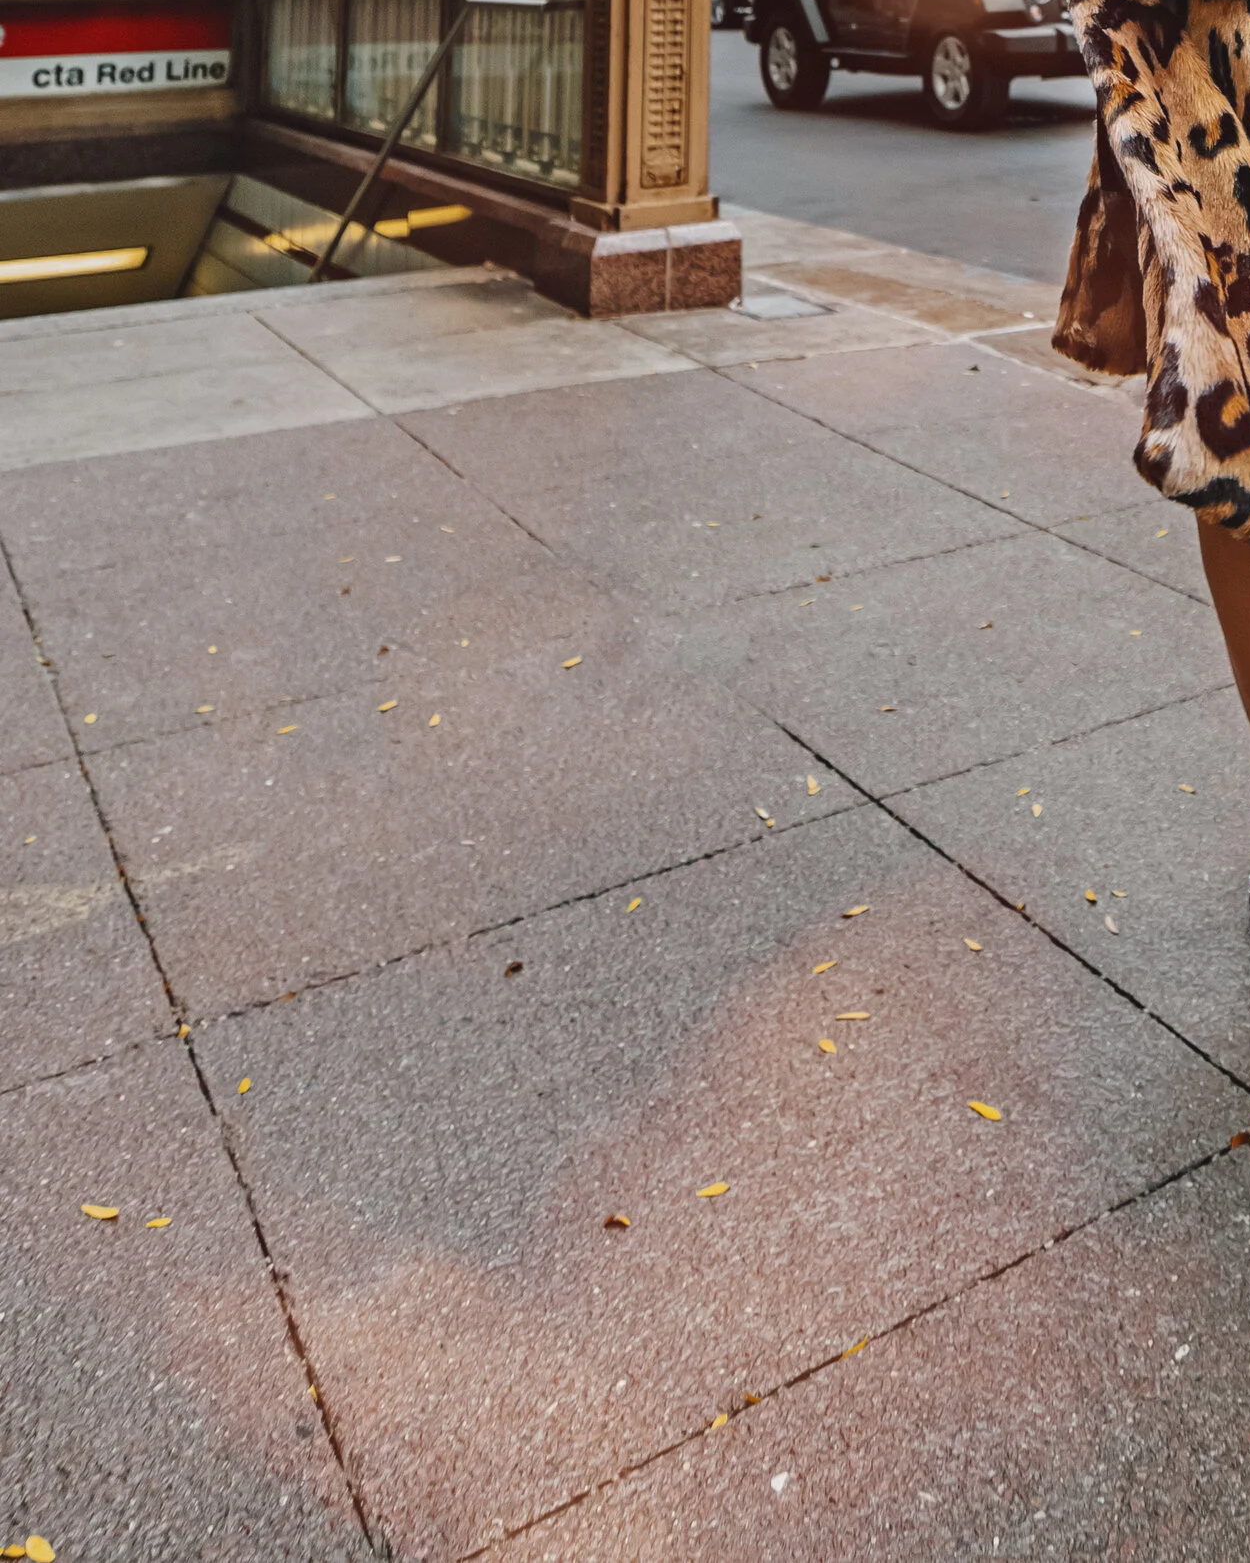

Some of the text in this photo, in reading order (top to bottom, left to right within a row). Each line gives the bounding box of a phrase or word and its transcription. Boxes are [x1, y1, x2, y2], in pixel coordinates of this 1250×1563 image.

[32, 59, 226, 88] cta Red Line
